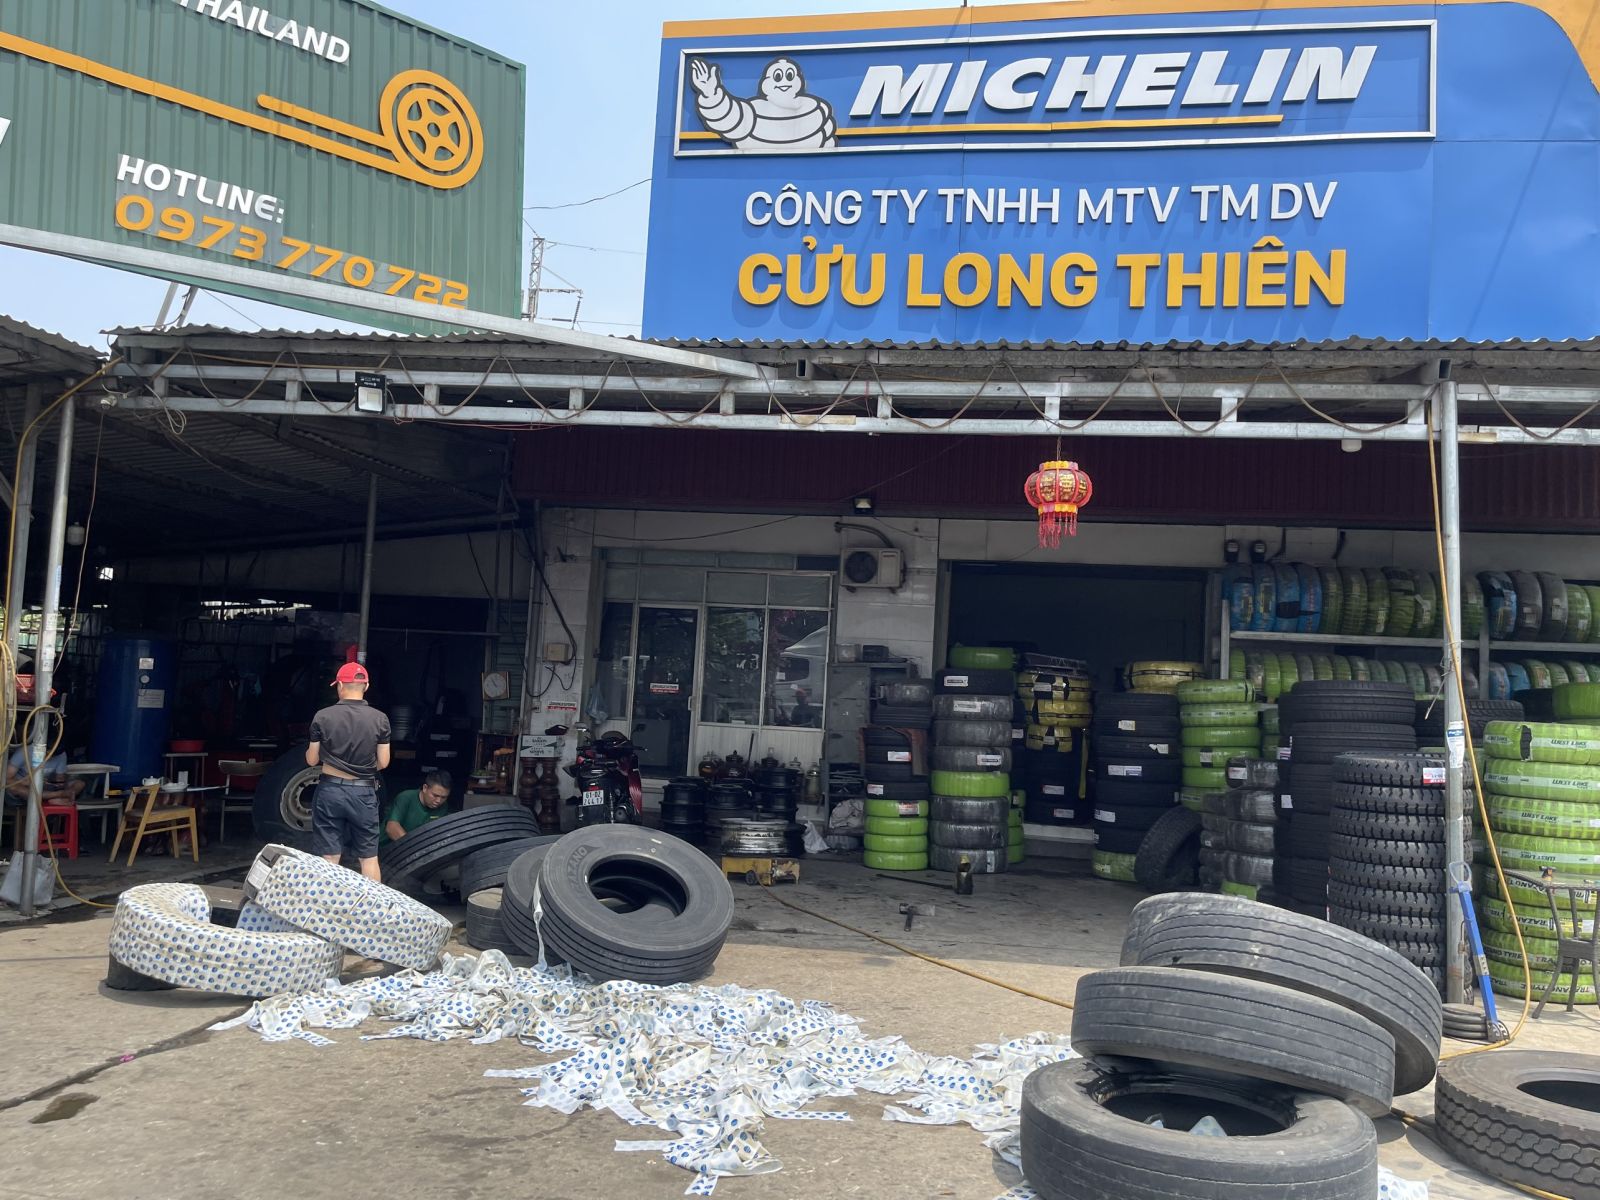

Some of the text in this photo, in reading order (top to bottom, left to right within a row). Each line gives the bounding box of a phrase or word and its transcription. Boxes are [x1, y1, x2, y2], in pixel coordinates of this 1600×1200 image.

[849, 45, 1378, 118] MICHELIN
[116, 153, 285, 223] HOTLINE:
[745, 181, 1338, 227] CÔNG TY TNHH MTV TM DV
[115, 194, 470, 309] 0973 770 722
[738, 235, 1347, 309] CỬU LONG THIÊN
